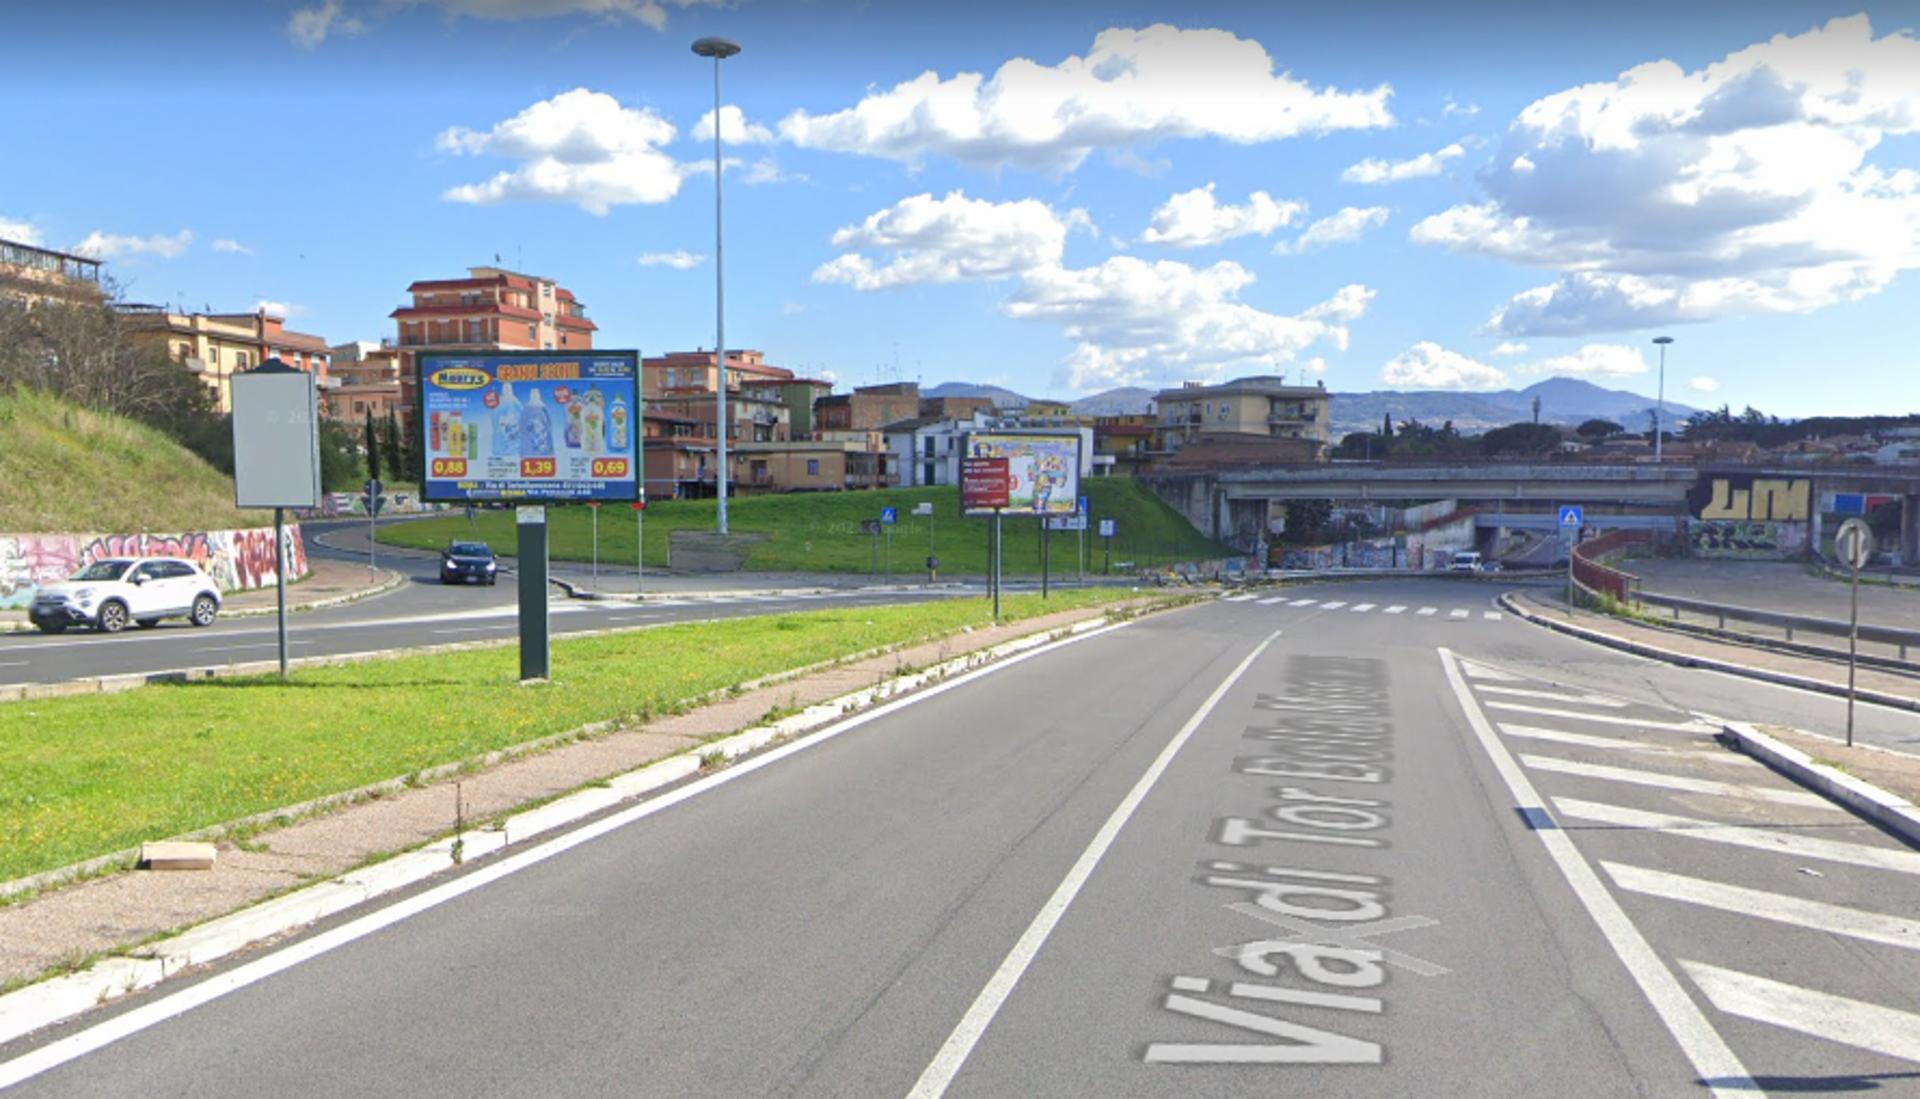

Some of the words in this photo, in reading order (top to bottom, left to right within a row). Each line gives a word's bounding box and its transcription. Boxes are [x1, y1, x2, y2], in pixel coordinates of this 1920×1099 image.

[433, 460, 465, 476] 0,88
[524, 460, 552, 476] 1,39
[594, 460, 625, 476] 0,69
